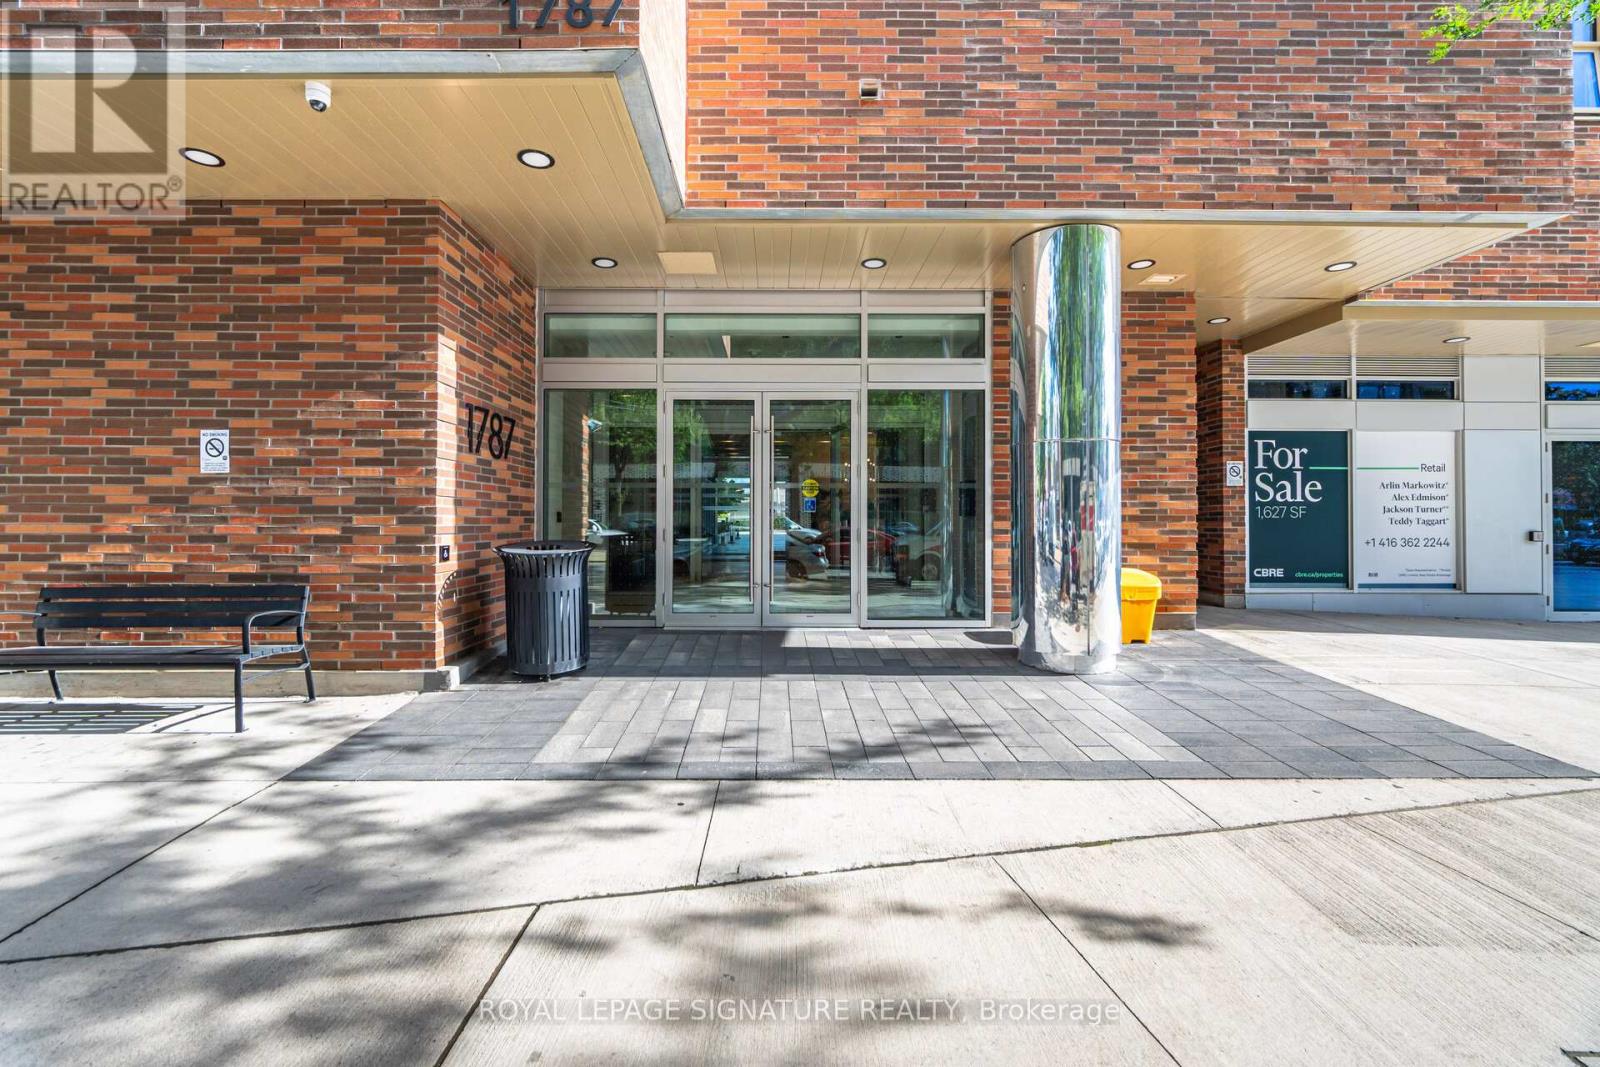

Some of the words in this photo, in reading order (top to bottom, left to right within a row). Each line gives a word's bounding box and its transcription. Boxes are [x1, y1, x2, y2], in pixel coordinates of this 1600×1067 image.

[465, 403, 516, 459] 1787
[1254, 439, 1308, 469] For
[1420, 463, 1446, 473] Retail
[1255, 470, 1322, 502] Sale
[1380, 481, 1400, 489] Arlin
[1392, 493, 1410, 501] Alex
[1255, 506, 1287, 519] 1,627
[1290, 506, 1307, 519] SF
[1383, 505, 1413, 514] Jackson
[1389, 517, 1413, 527] Teddy
[1364, 537, 1376, 547] +1
[1378, 537, 1398, 548] 416
[1400, 537, 1420, 548] 362
[1423, 537, 1450, 548] 2244
[1253, 568, 1284, 577] CBRE
